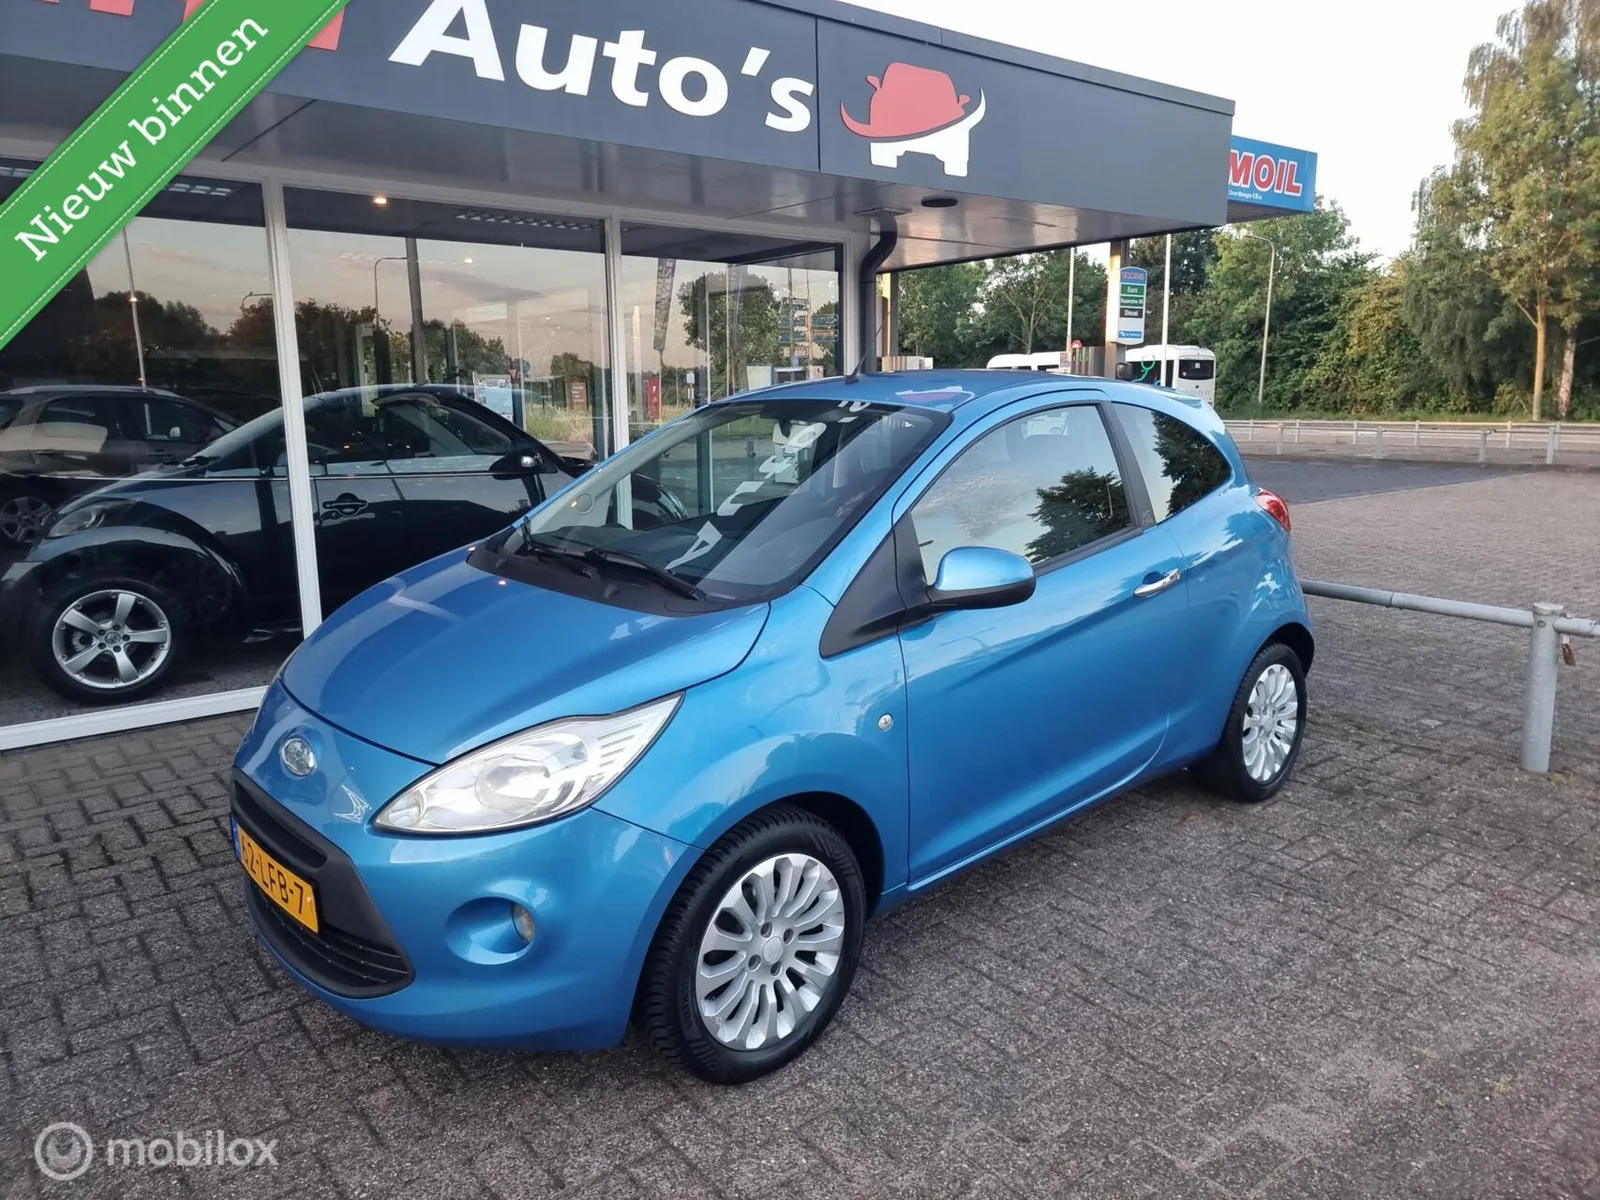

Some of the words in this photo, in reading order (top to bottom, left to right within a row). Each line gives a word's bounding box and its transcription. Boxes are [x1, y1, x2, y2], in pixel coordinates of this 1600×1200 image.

[387, 0, 815, 133] Auto's
[1229, 149, 1303, 197] MOIL
[241, 835, 305, 914] 62-LFB-7
